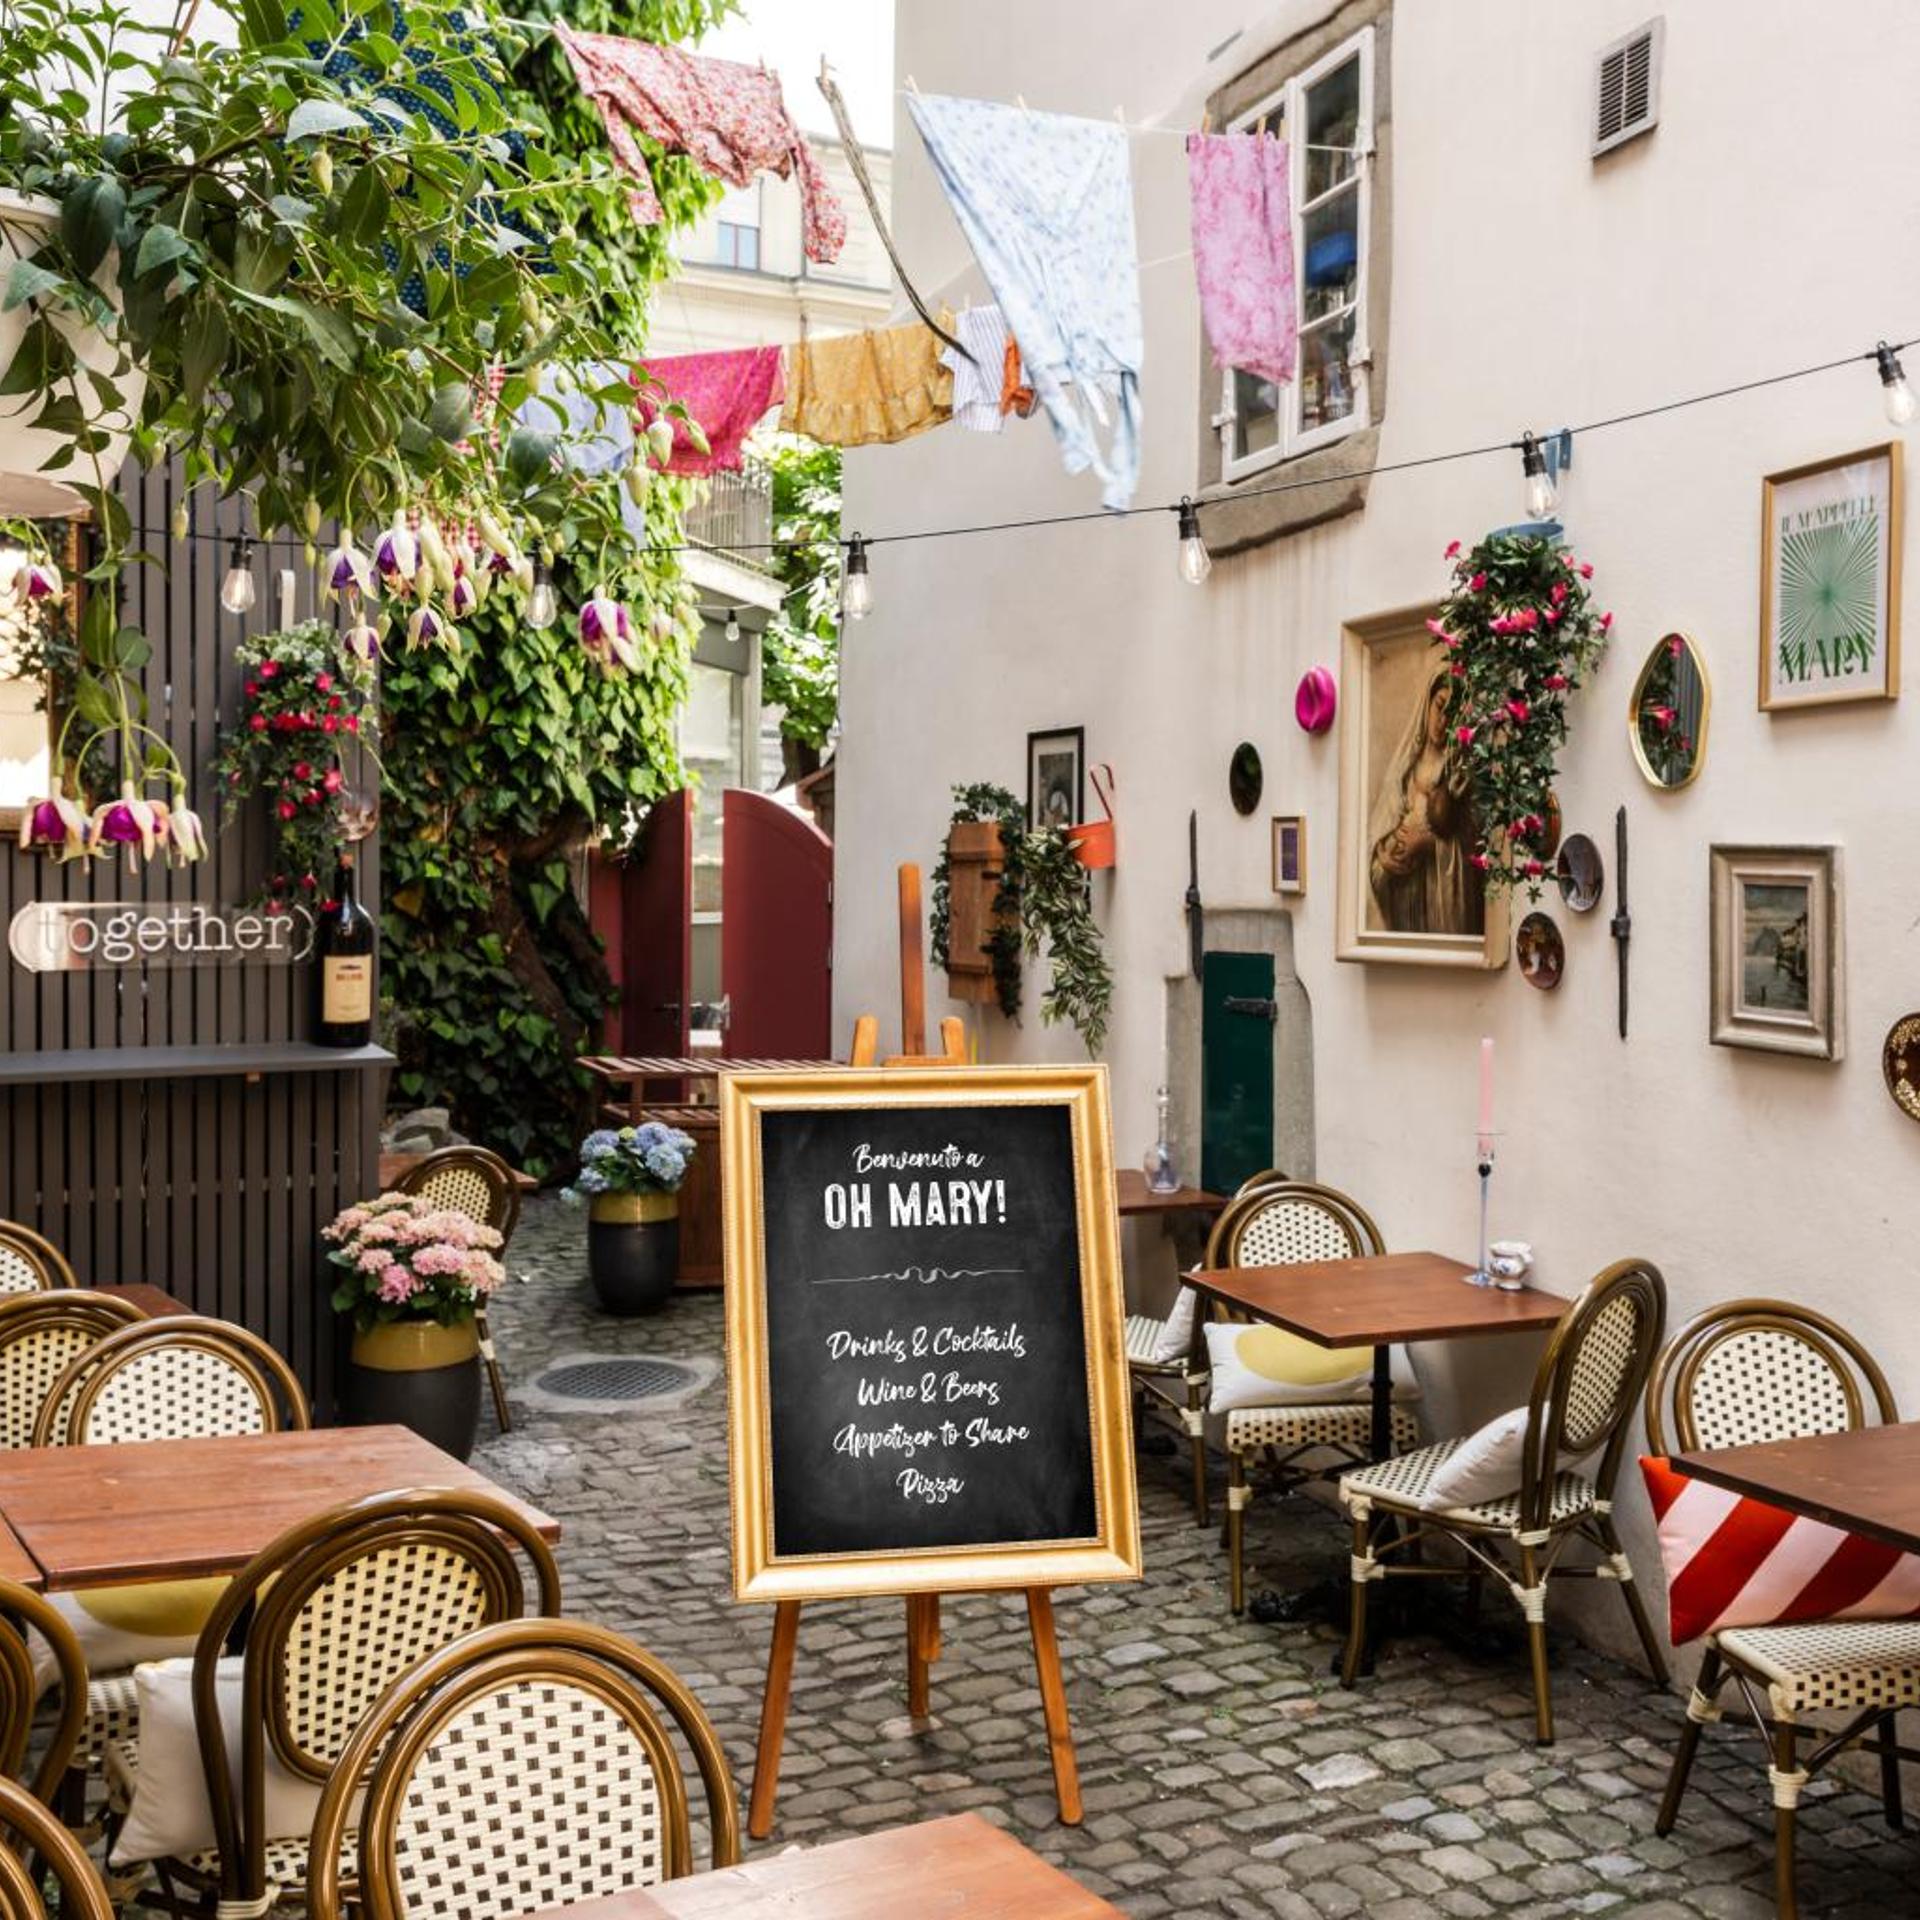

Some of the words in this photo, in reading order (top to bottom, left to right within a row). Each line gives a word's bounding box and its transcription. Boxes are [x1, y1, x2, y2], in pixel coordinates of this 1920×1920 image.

[1778, 631, 1874, 684] MARY
[852, 1143, 962, 1173] Benvenuto
[964, 1151, 985, 1169] a
[824, 1183, 872, 1229] OH
[888, 1179, 1006, 1227] MARY!
[826, 1329, 906, 1363] Drinks
[912, 1326, 928, 1357] &
[933, 1322, 1026, 1357] Cocktails
[857, 1377, 917, 1406] Wine
[920, 1372, 937, 1403] &
[941, 1371, 1001, 1406] Beers
[833, 1422, 938, 1458] Appetizer
[939, 1420, 960, 1447] to
[965, 1417, 1030, 1447] Share
[895, 1468, 965, 1503] Pizza
